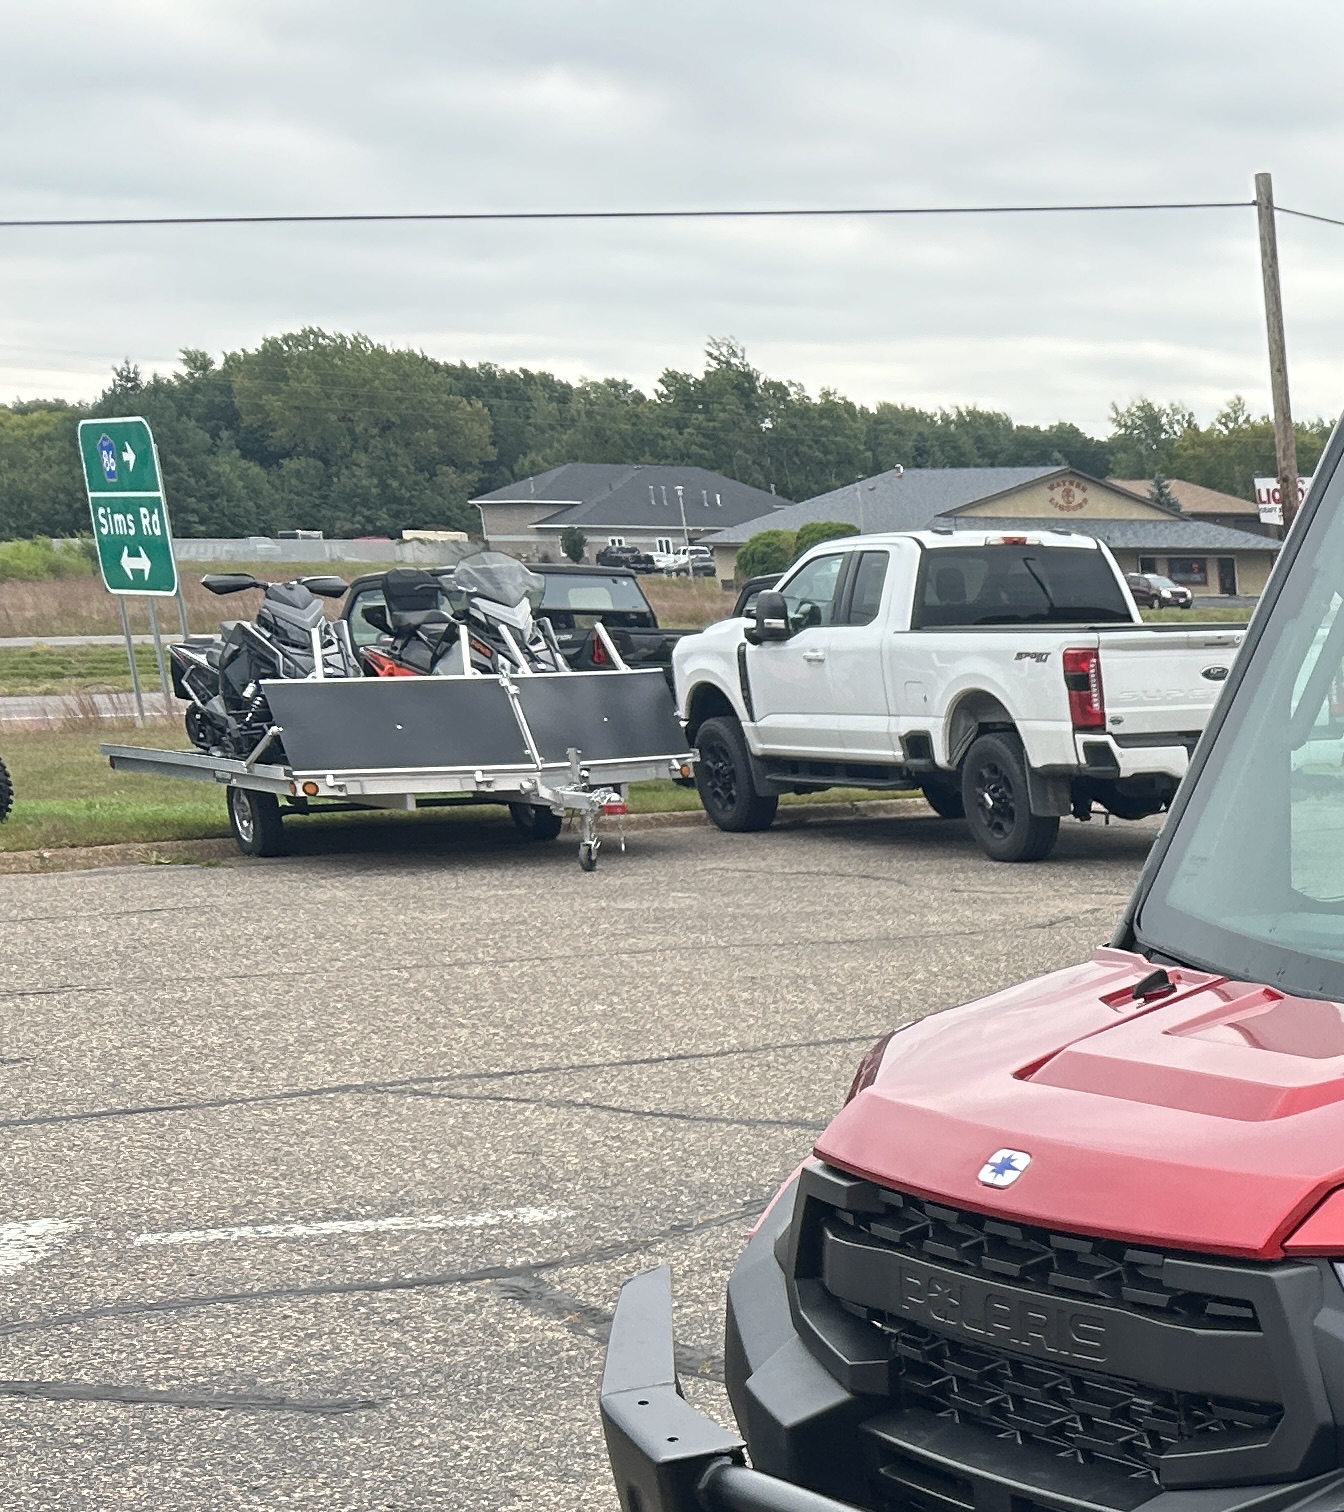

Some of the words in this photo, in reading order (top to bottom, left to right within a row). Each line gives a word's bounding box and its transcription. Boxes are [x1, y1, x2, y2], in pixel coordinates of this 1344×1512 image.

[98, 507, 135, 536] Sims
[139, 507, 161, 536] Rd
[902, 1267, 1108, 1363] POLARIS
